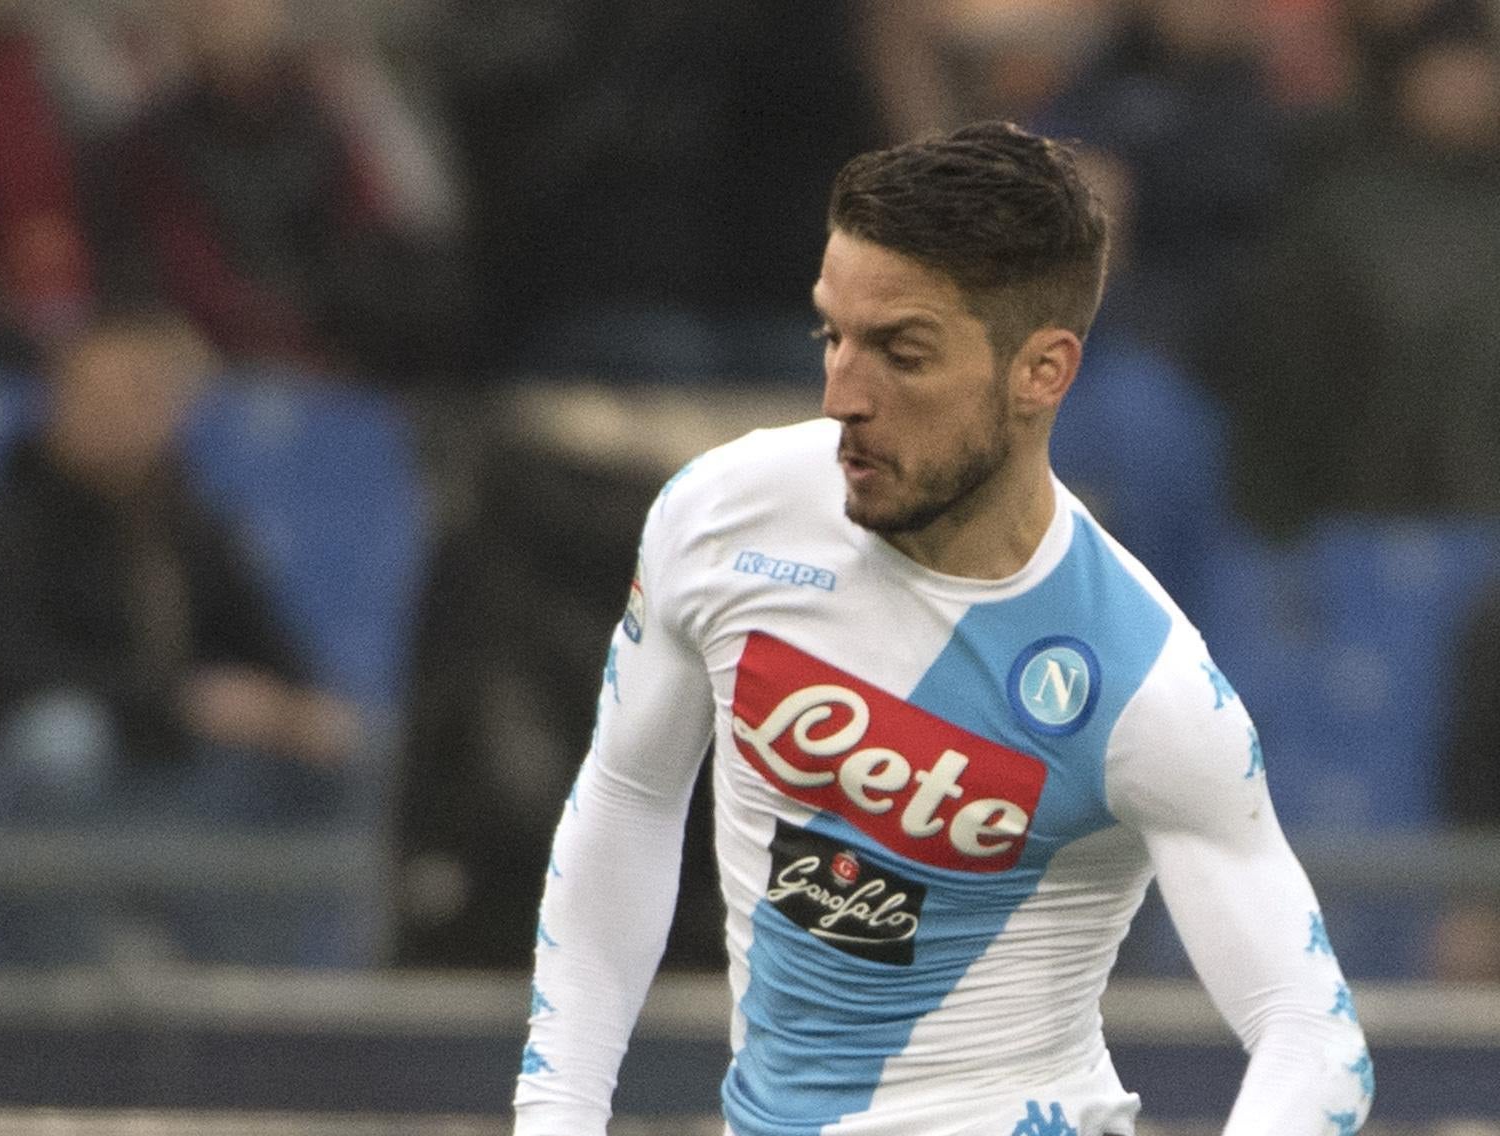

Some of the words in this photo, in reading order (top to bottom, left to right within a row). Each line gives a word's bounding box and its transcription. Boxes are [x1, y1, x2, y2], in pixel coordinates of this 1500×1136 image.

[733, 551, 837, 591] Kappa
[1031, 658, 1076, 713] N
[732, 684, 1029, 858] Lete
[767, 856, 919, 943] Garofalo
